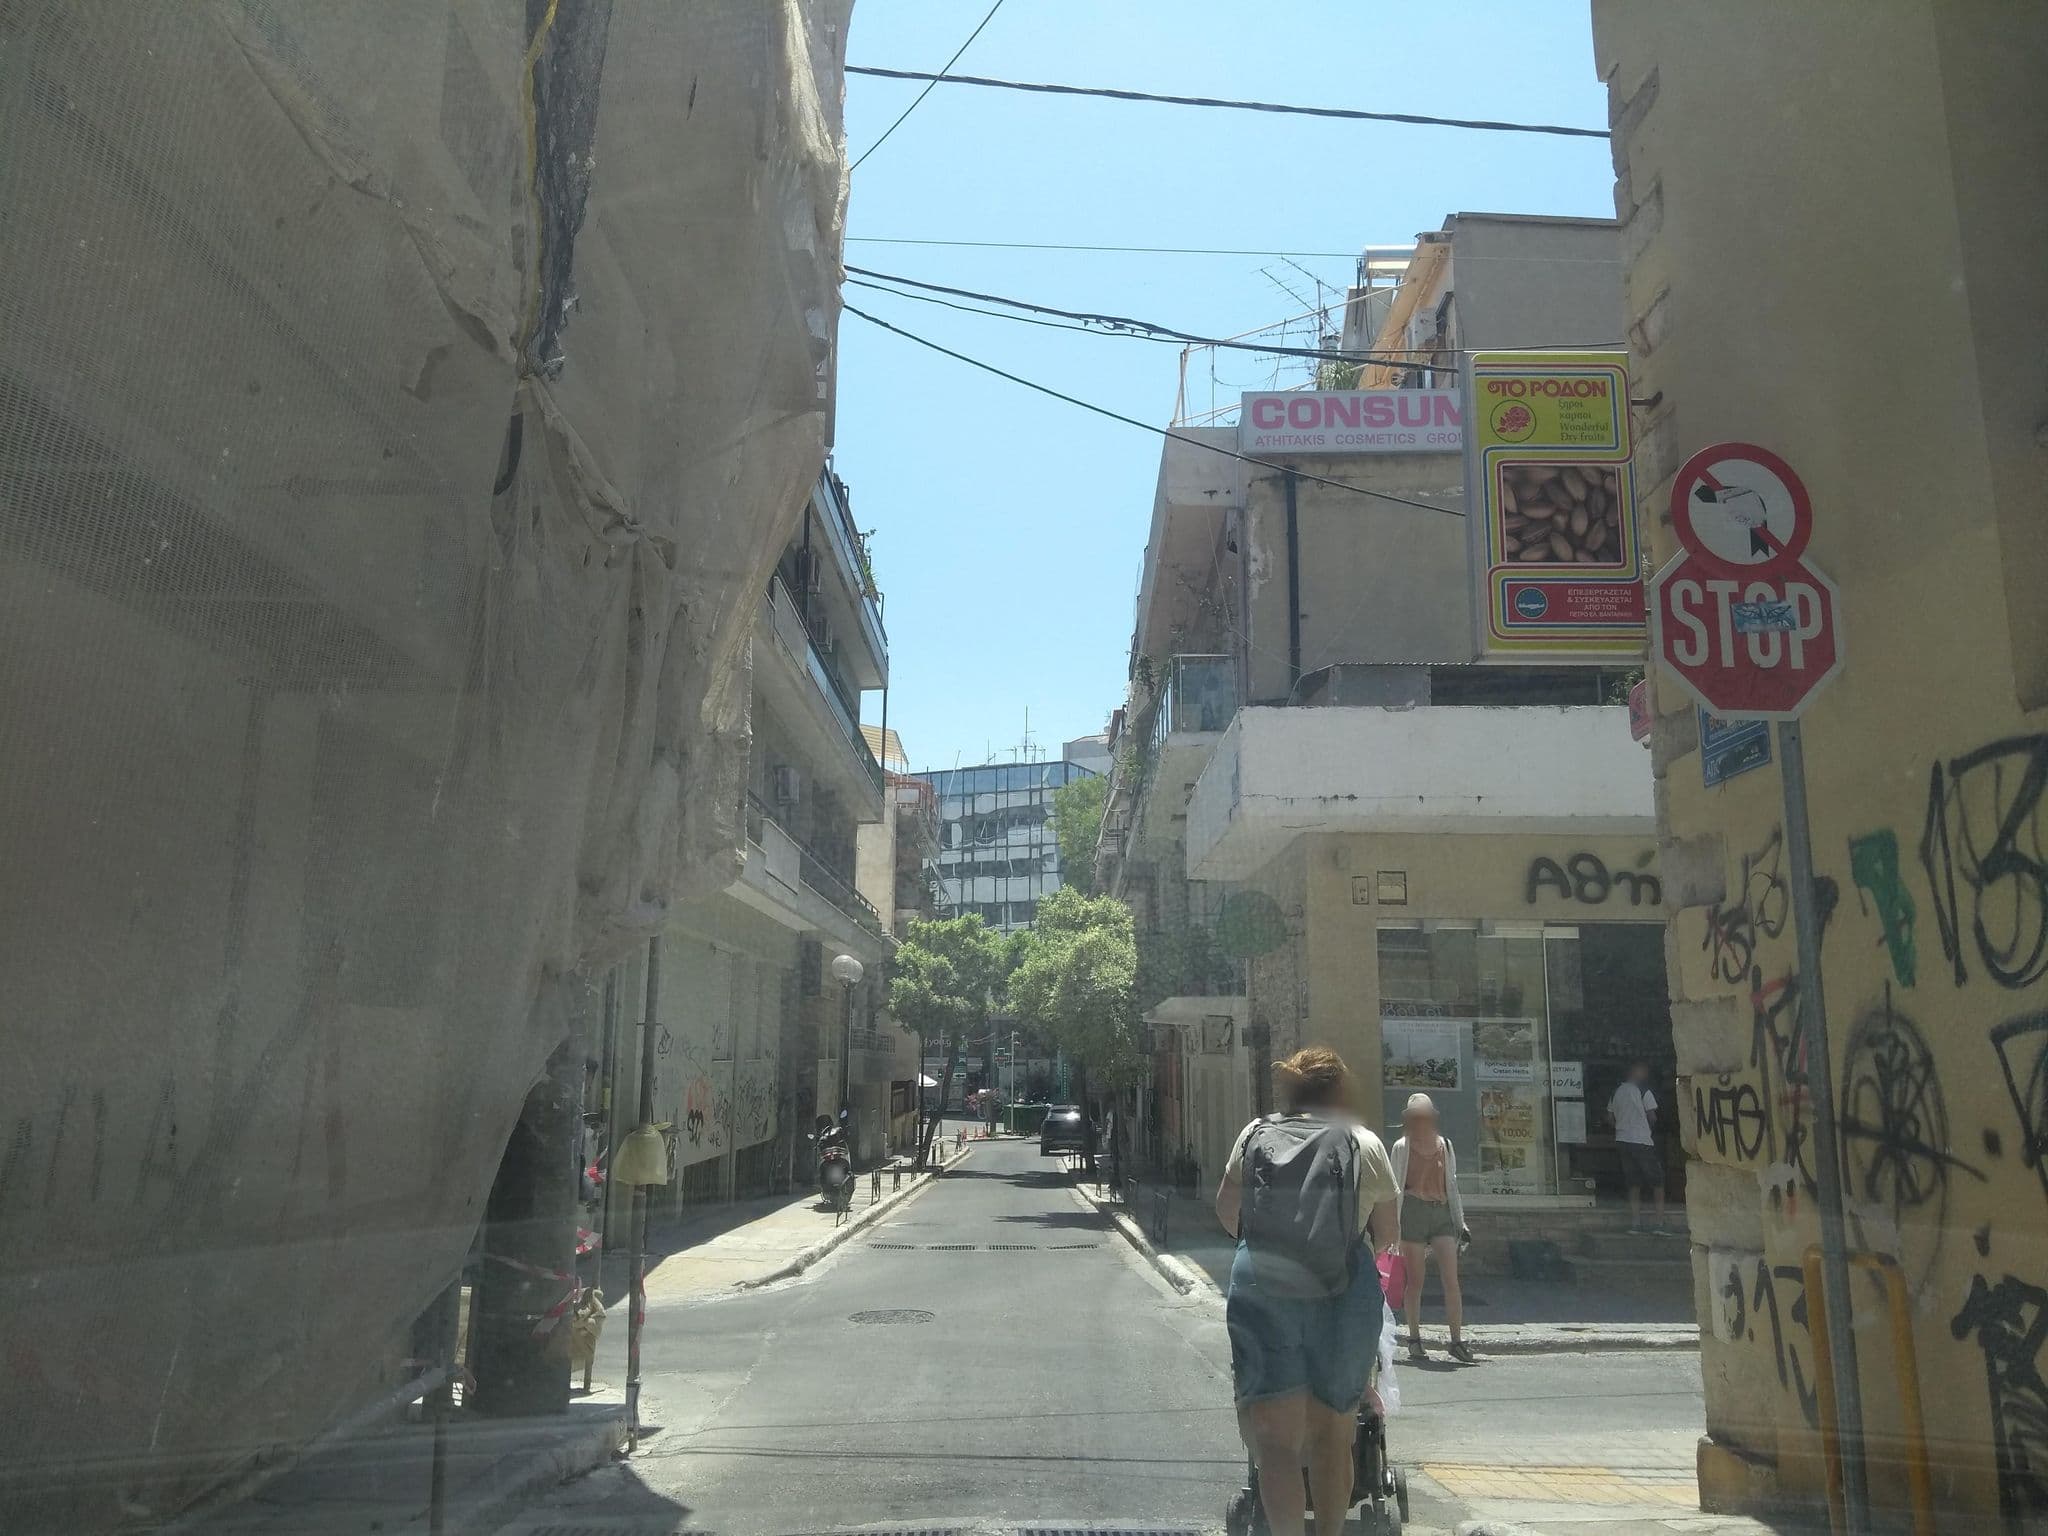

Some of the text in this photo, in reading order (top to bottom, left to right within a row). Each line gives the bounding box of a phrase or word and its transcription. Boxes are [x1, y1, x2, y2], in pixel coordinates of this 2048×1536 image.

[1529, 380, 1607, 399] ΡΟΔΟΝ
[1559, 422, 1610, 432] Wonderful
[1255, 434, 1326, 447] ATHITAKIS
[1334, 433, 1417, 446] COSMETICS
[1670, 579, 1824, 670] STOP
